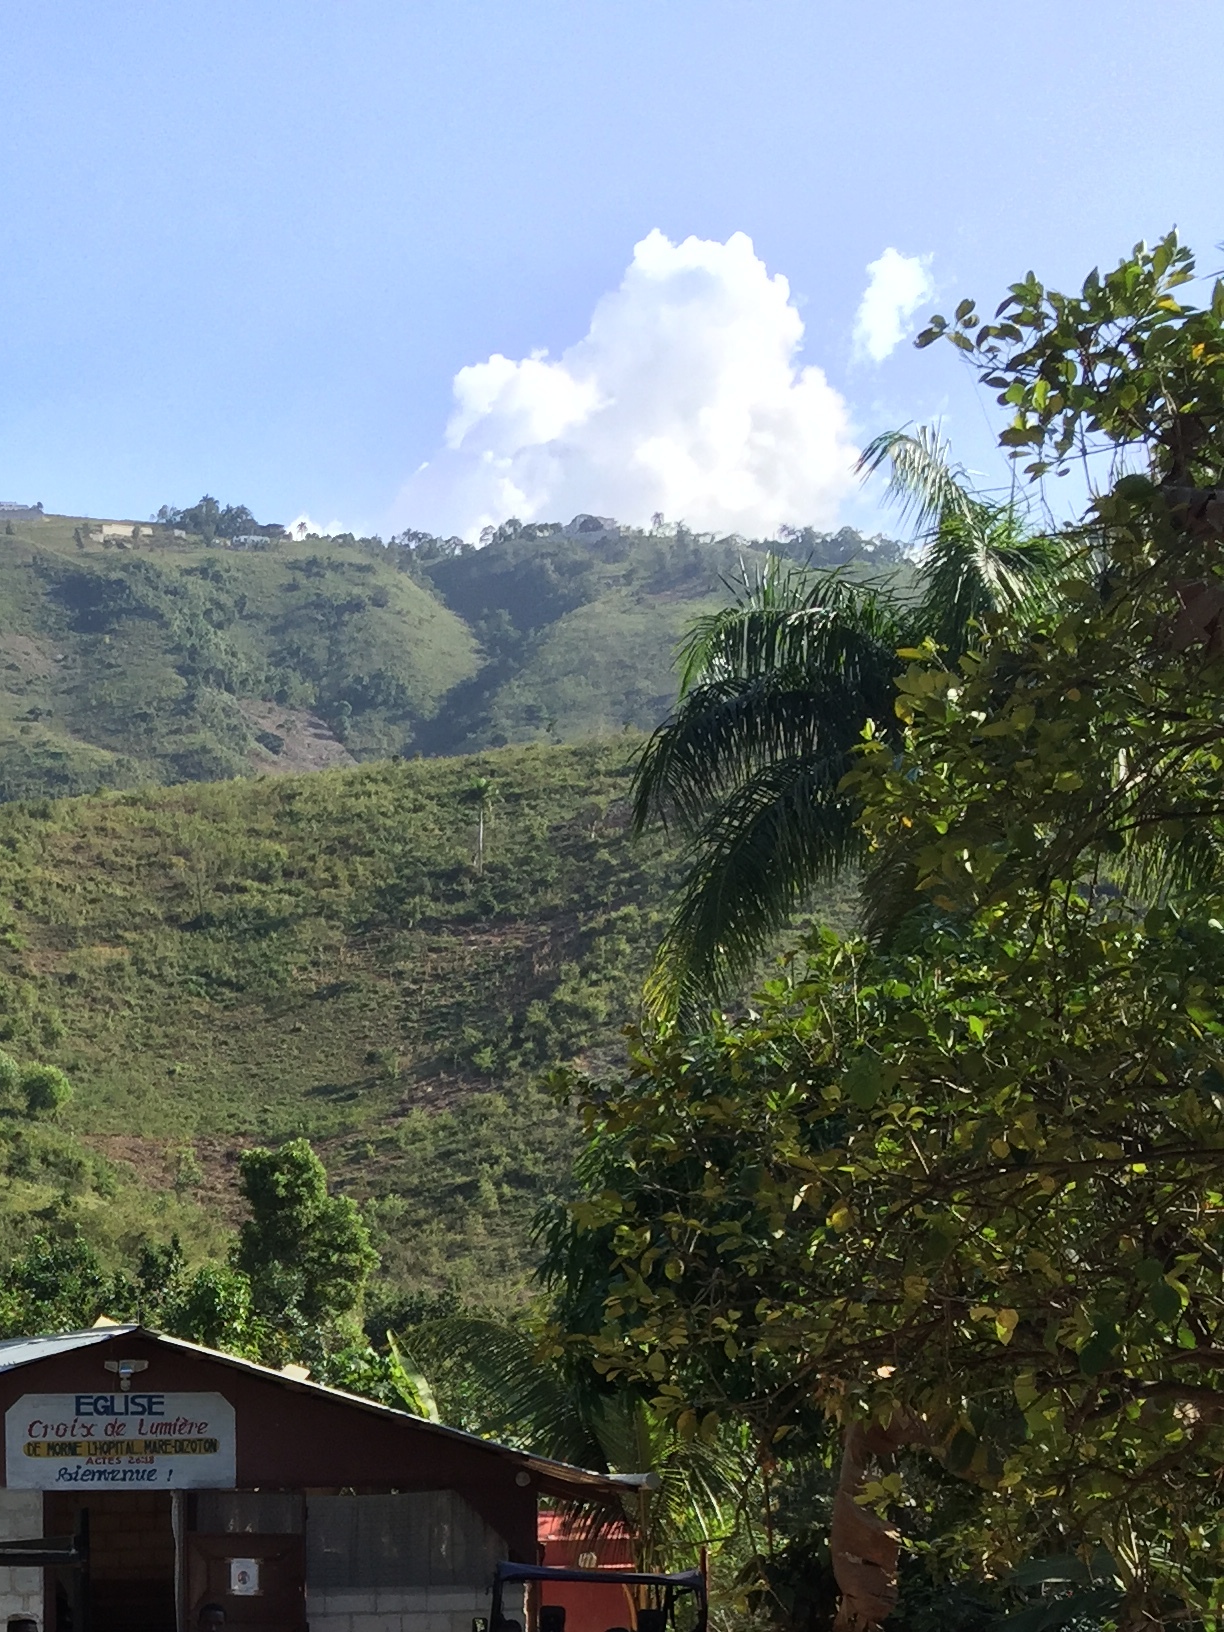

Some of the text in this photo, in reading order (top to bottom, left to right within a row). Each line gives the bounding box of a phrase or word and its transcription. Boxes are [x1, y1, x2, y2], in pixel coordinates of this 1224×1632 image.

[75, 1394, 165, 1416] EGLISE
[27, 1417, 209, 1439] Croix de Lumière
[26, 1442, 42, 1457] DE
[46, 1441, 83, 1457] MORNE
[85, 1456, 122, 1466] ACTES
